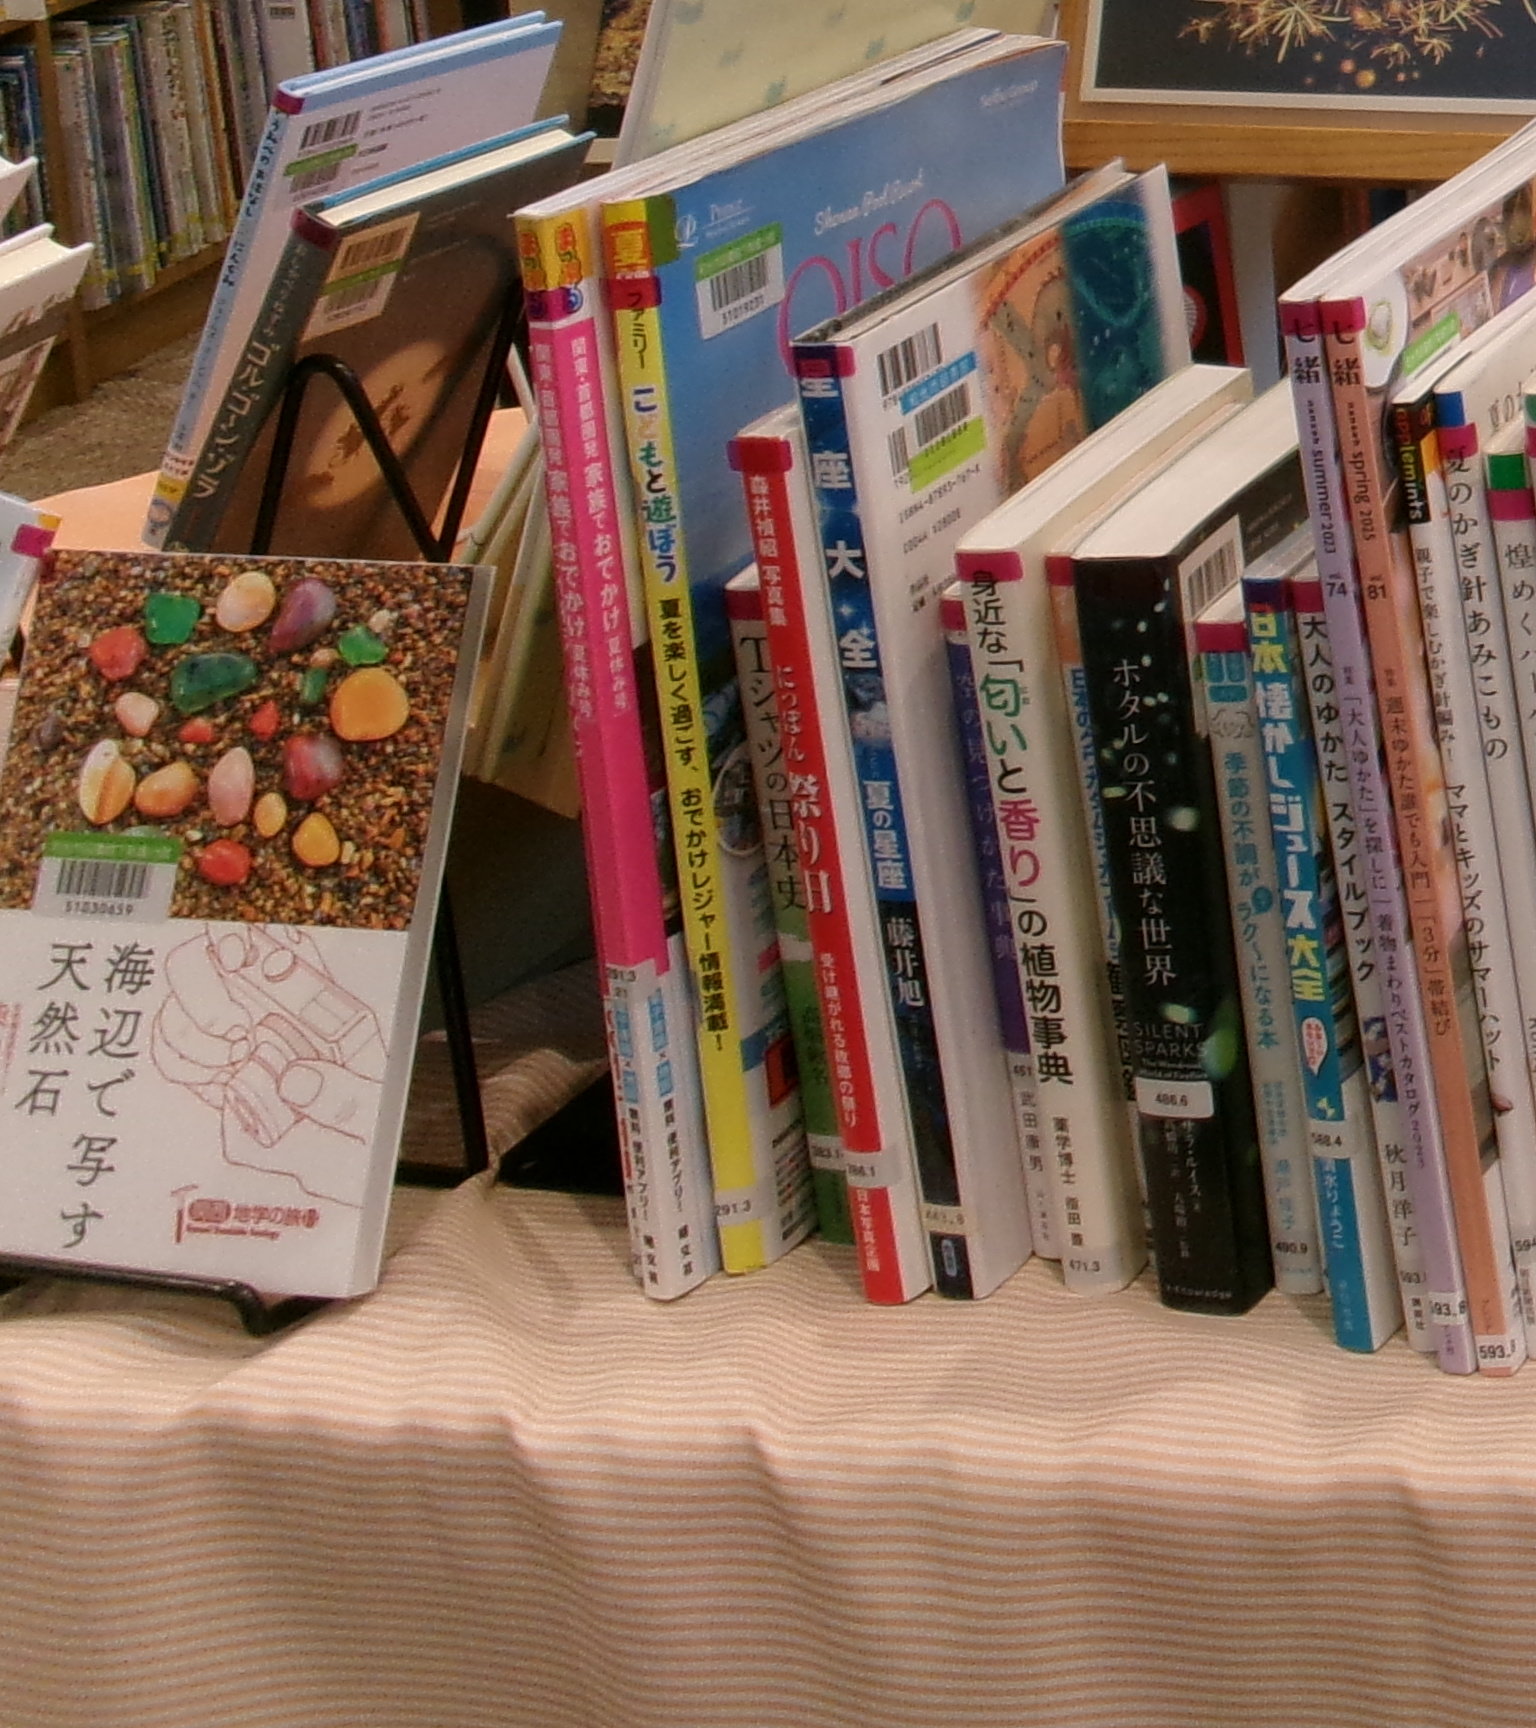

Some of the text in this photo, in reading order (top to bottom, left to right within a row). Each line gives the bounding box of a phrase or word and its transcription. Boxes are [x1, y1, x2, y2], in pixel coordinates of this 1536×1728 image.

[631, 385, 677, 585] こどもと遊ぼう
[659, 598, 700, 772] 夏を楽しく過ごす、
[1312, 449, 1336, 517] summer
[1326, 582, 1348, 598] 74
[1351, 451, 1370, 505] spring
[1367, 583, 1388, 600] 81
[1445, 446, 1508, 759] 夏のかぎ針あみこもの
[862, 781, 907, 889] 夏の星座
[885, 916, 924, 1008] 藤井旭
[971, 570, 1073, 1084] 身近な「匂いと香り」の植物事典
[1113, 659, 1176, 987] ホタルの不思議な世界
[1302, 617, 1375, 983] 大人のゆかた スタイルブック
[1447, 783, 1500, 1070] ママとキッズのサマーハット
[15, 943, 95, 1118] 天然石
[60, 942, 156, 1248] 海辺で写す
[1133, 1022, 1202, 1040] SILENT
